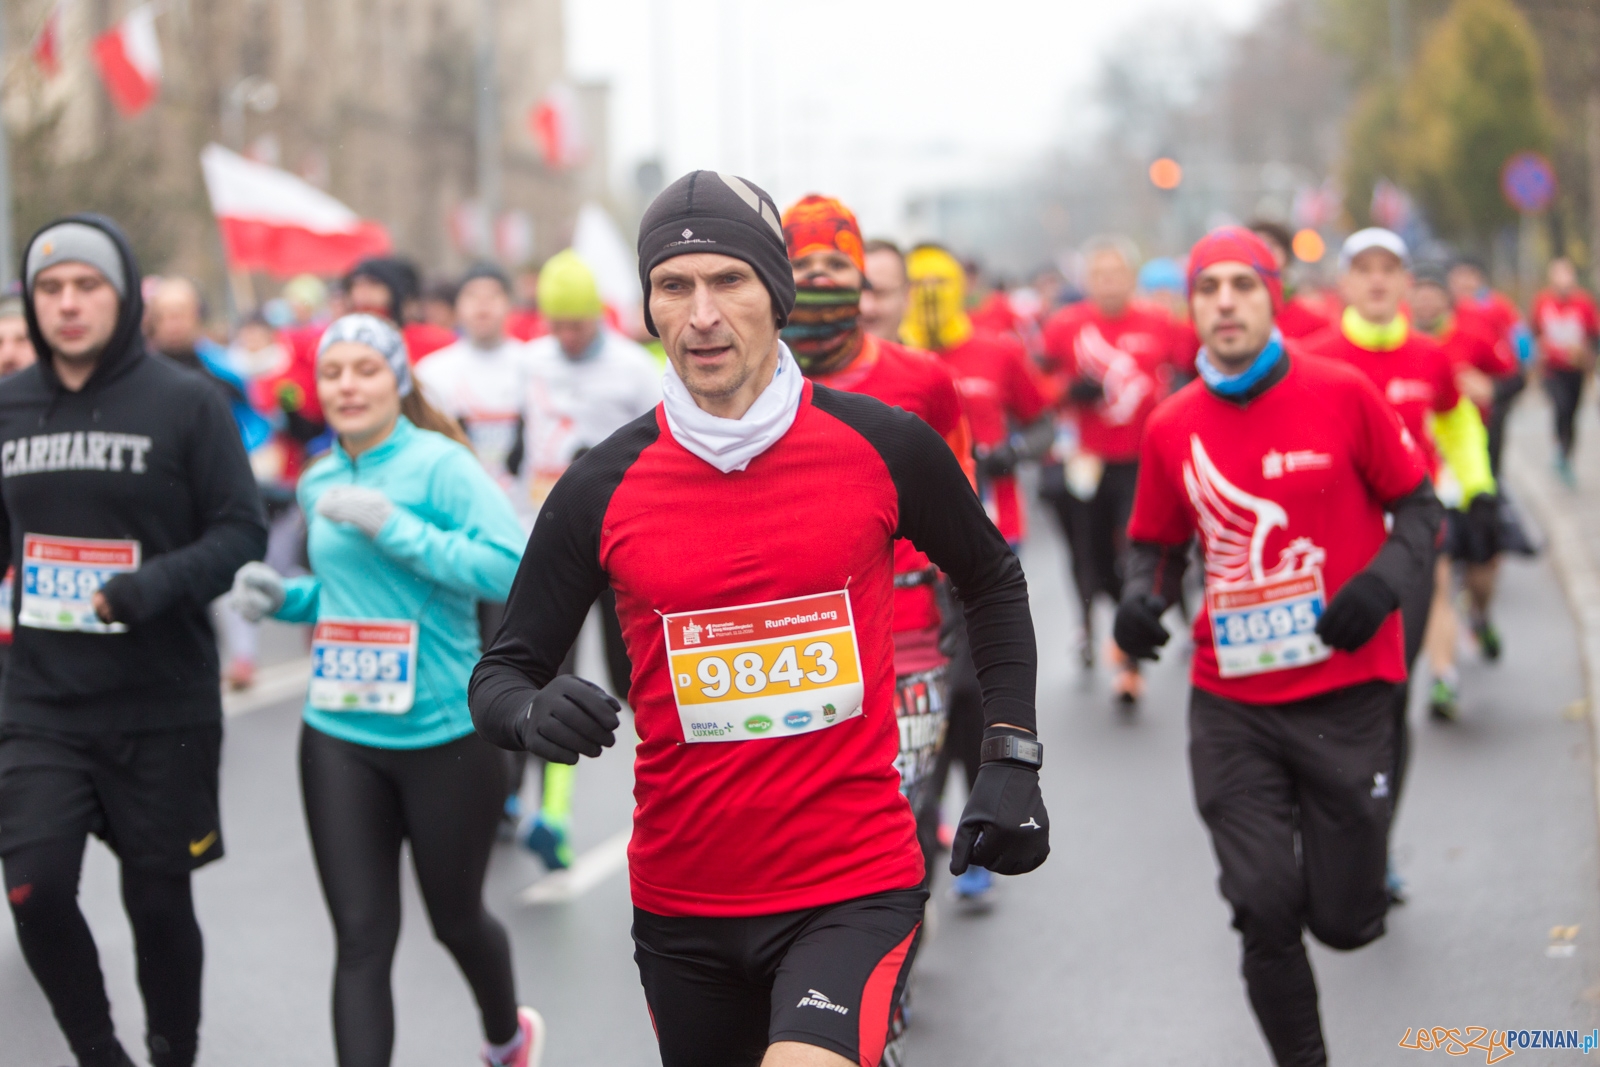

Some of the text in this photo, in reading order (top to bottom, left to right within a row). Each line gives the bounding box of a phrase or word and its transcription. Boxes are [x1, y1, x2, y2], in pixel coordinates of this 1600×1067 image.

[663, 238, 716, 249] RONHILL
[1, 430, 153, 478] CARHARTT
[765, 610, 838, 629] RunPoland.org
[1224, 601, 1317, 644] 8695
[321, 647, 401, 682] 5595
[678, 641, 838, 698] D 9843
[691, 722, 718, 730] GRUPA
[693, 728, 725, 737] LUXMED
[796, 996, 849, 1015] Rogelli
